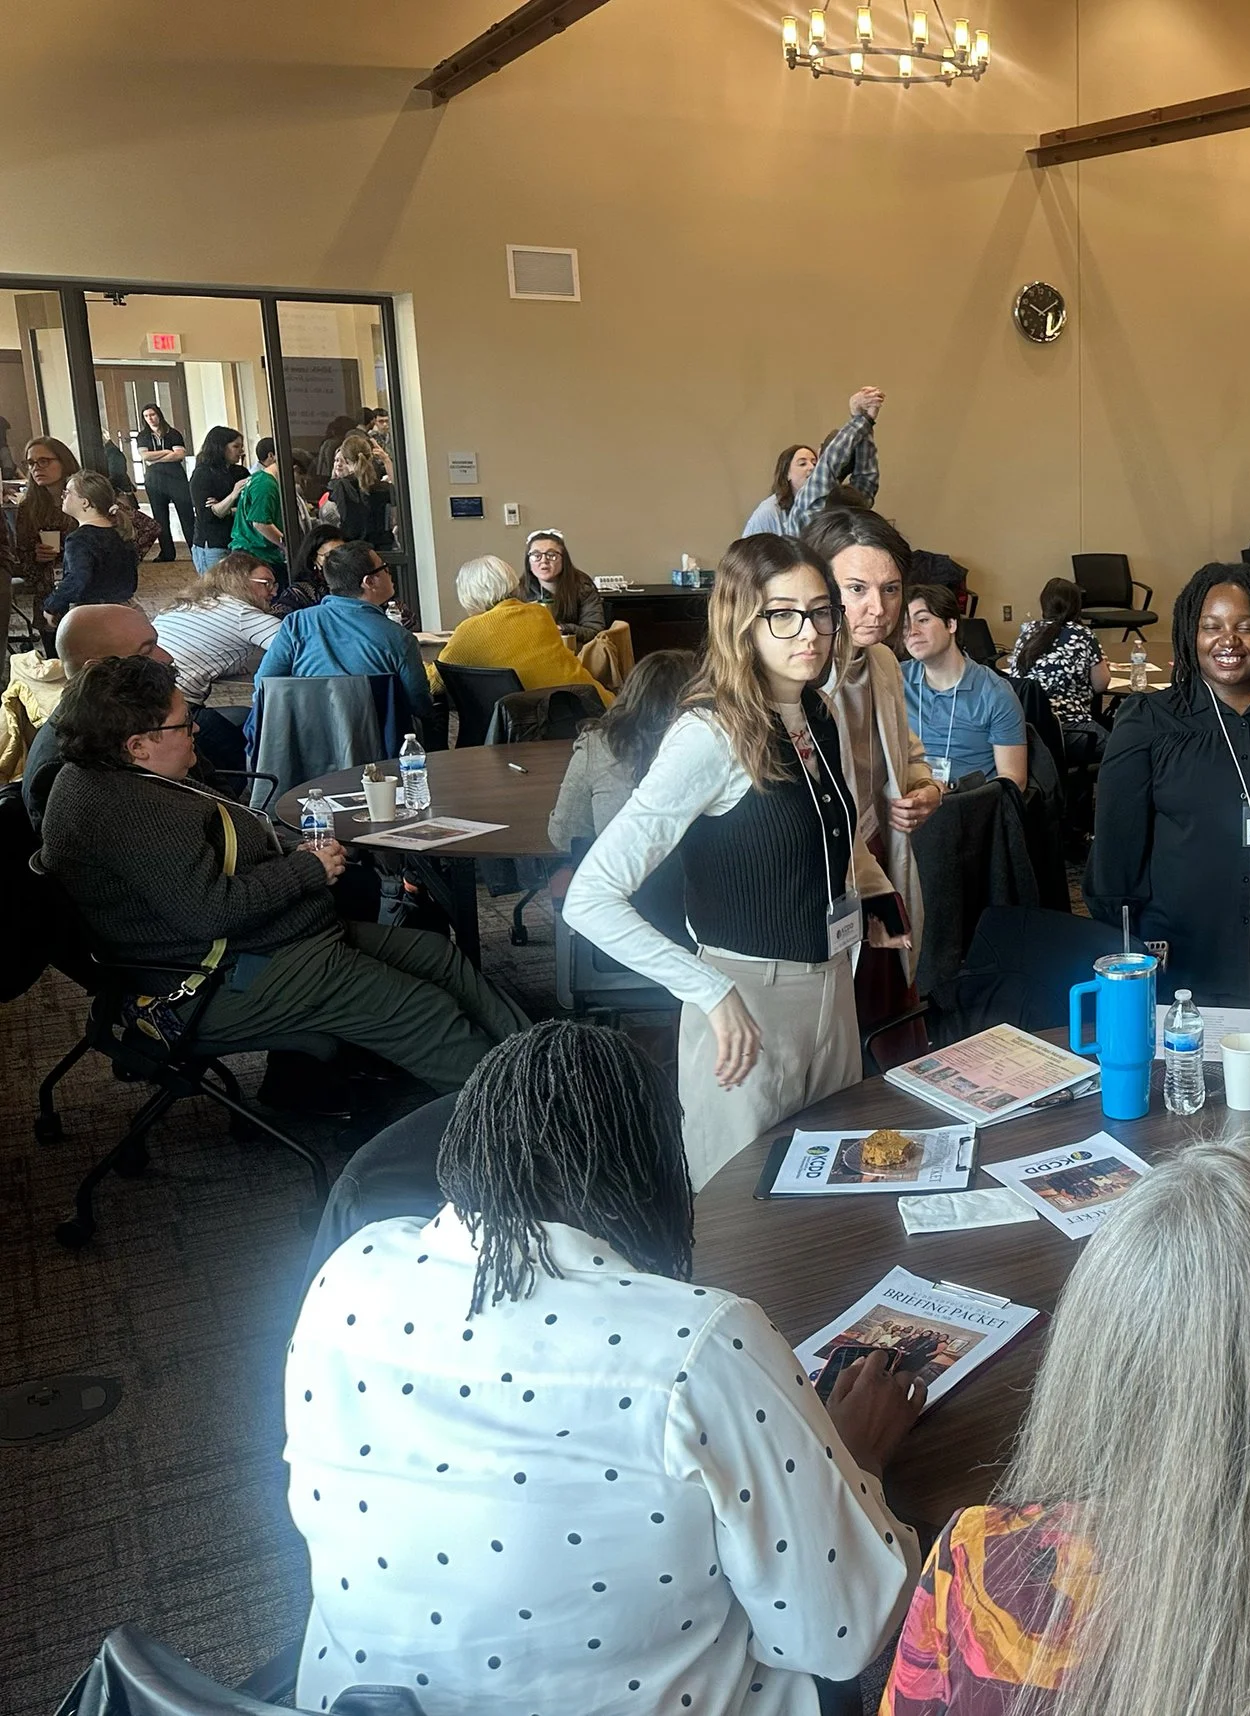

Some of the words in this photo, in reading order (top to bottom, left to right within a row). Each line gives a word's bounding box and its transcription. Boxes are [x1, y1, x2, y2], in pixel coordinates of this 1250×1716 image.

[153, 335, 175, 350] EXIT
[806, 1155, 828, 1179] KCDD
[1025, 1157, 1076, 1174] KCDD
[1066, 1206, 1111, 1225] ACKET
[883, 1288, 950, 1316] BRIEFING
[950, 1308, 1009, 1329] PACKET
